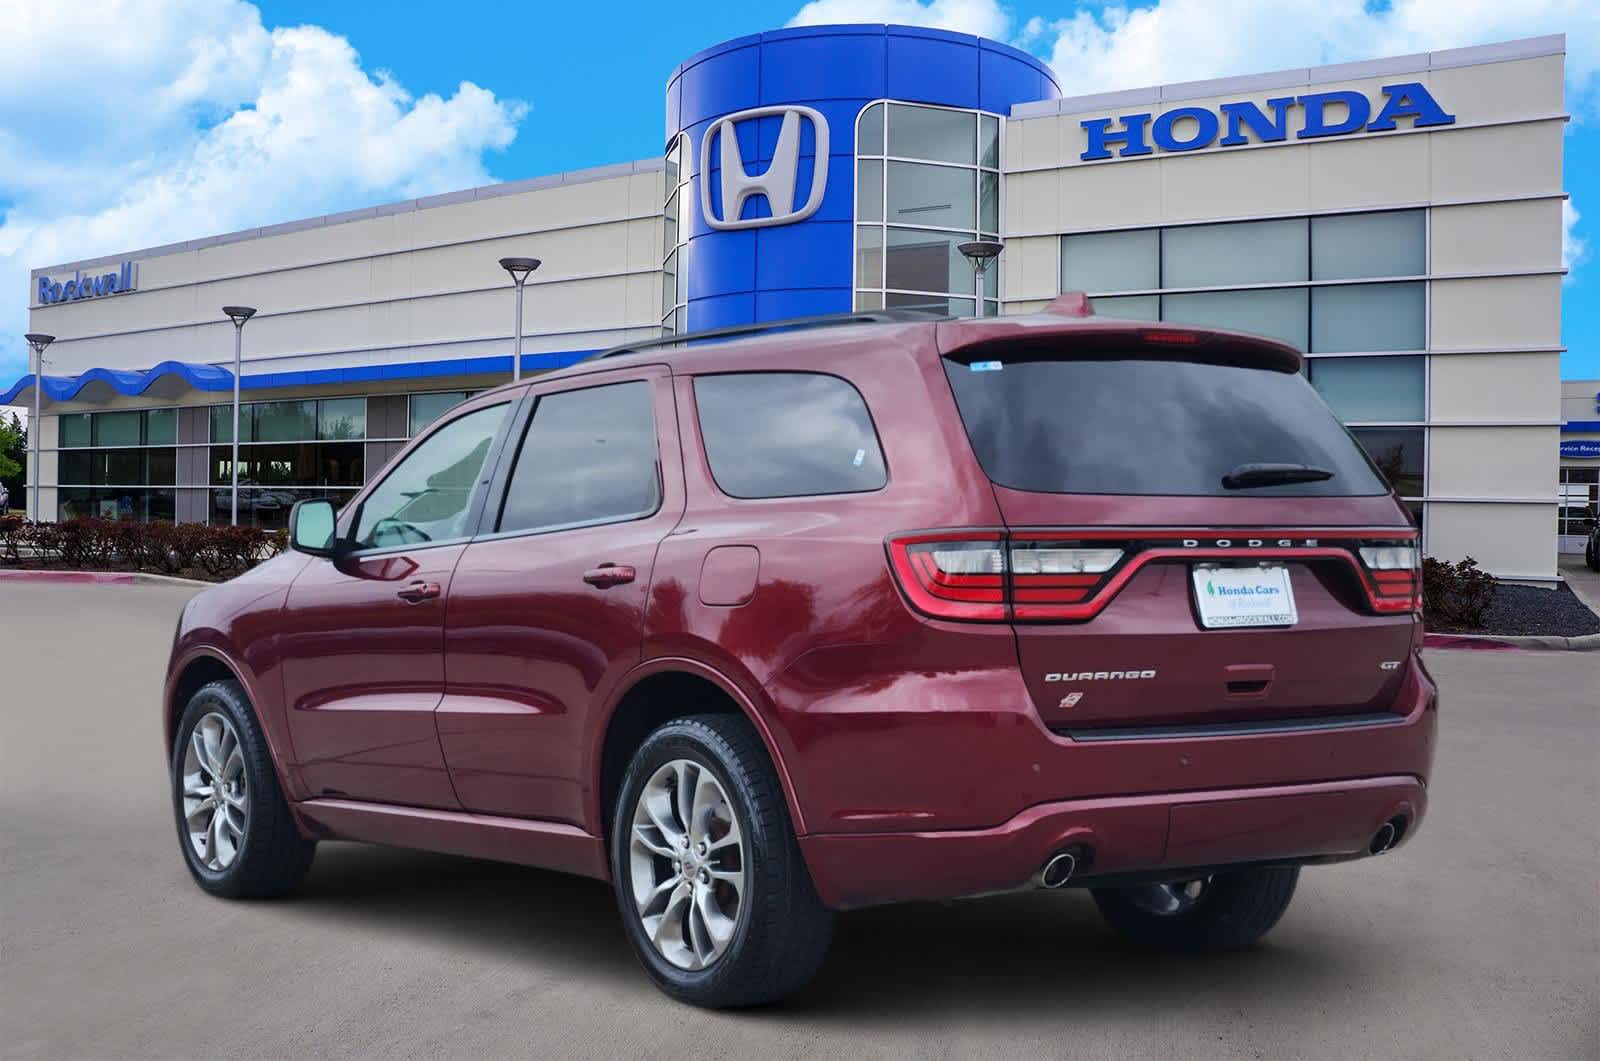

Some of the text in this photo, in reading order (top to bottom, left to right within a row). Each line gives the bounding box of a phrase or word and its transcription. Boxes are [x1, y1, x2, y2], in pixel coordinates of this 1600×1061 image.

[1080, 82, 1456, 161] HONDA
[38, 260, 133, 304] Rockwall
[1183, 539, 1318, 548] DODGE
[1217, 585, 1280, 596] Honda Cars
[1380, 661, 1401, 670] GT
[1044, 670, 1157, 682] DURANGO
